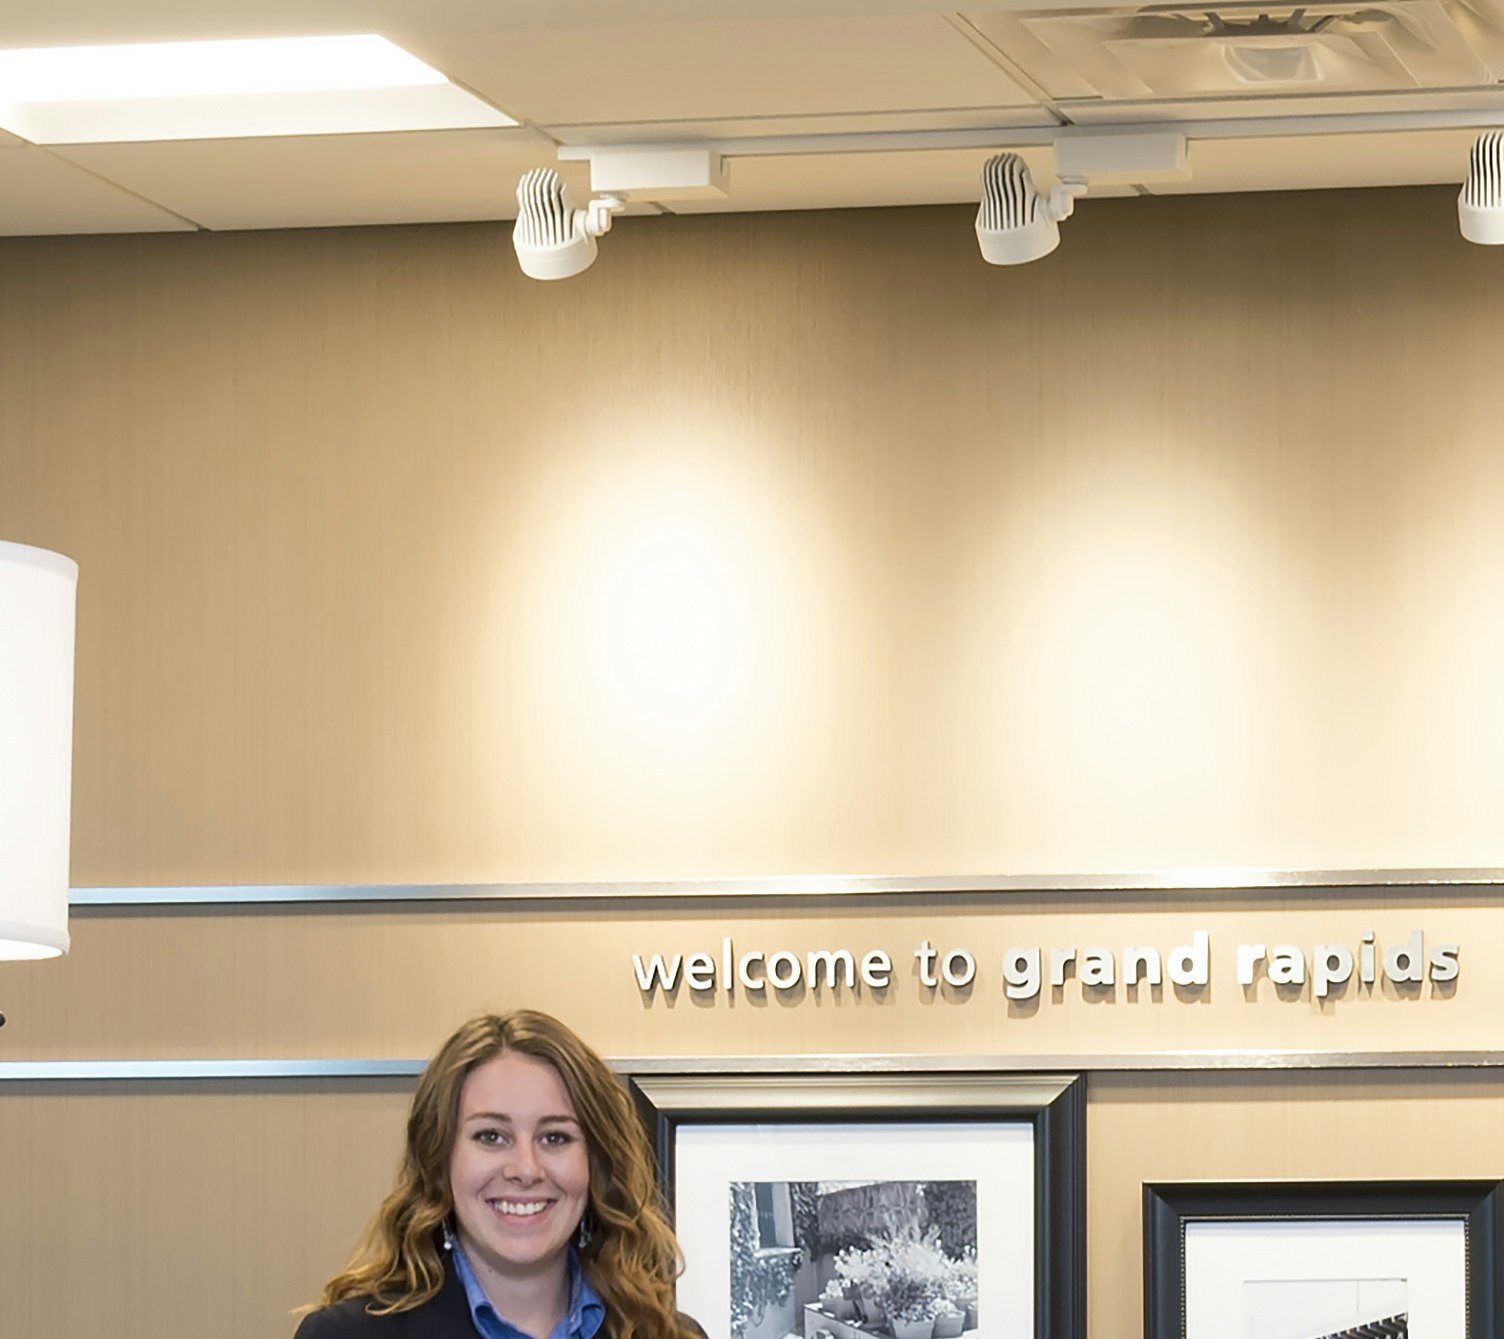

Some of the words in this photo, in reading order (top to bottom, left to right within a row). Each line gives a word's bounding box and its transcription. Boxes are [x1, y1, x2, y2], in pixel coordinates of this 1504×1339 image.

[632, 935, 892, 991] welcome
[913, 940, 976, 988] to
[1002, 930, 1210, 999] grand
[1237, 929, 1461, 998] rapids
